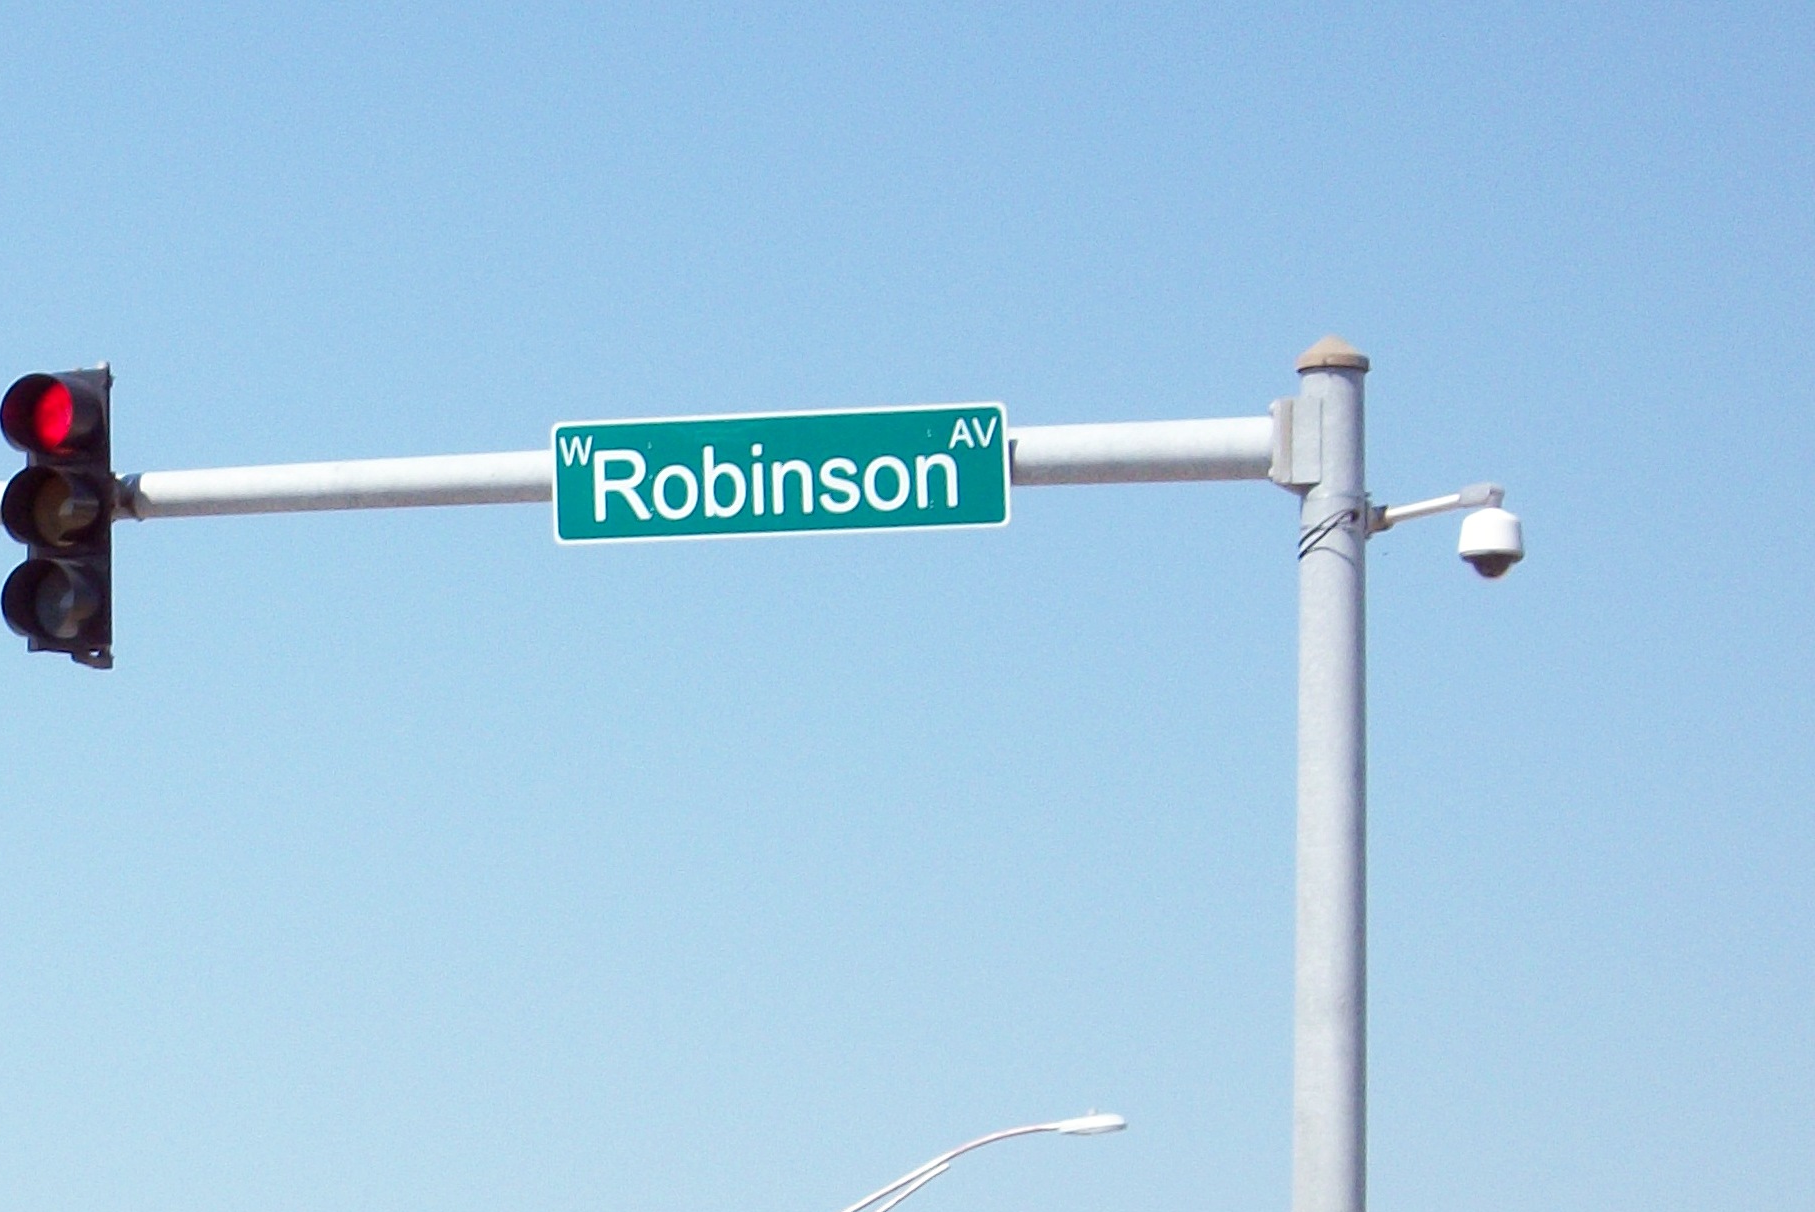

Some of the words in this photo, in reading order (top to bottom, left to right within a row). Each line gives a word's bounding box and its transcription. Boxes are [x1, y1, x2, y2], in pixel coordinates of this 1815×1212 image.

[559, 435, 593, 466] W
[593, 442, 959, 522] Robinson
[948, 416, 998, 449] AV
